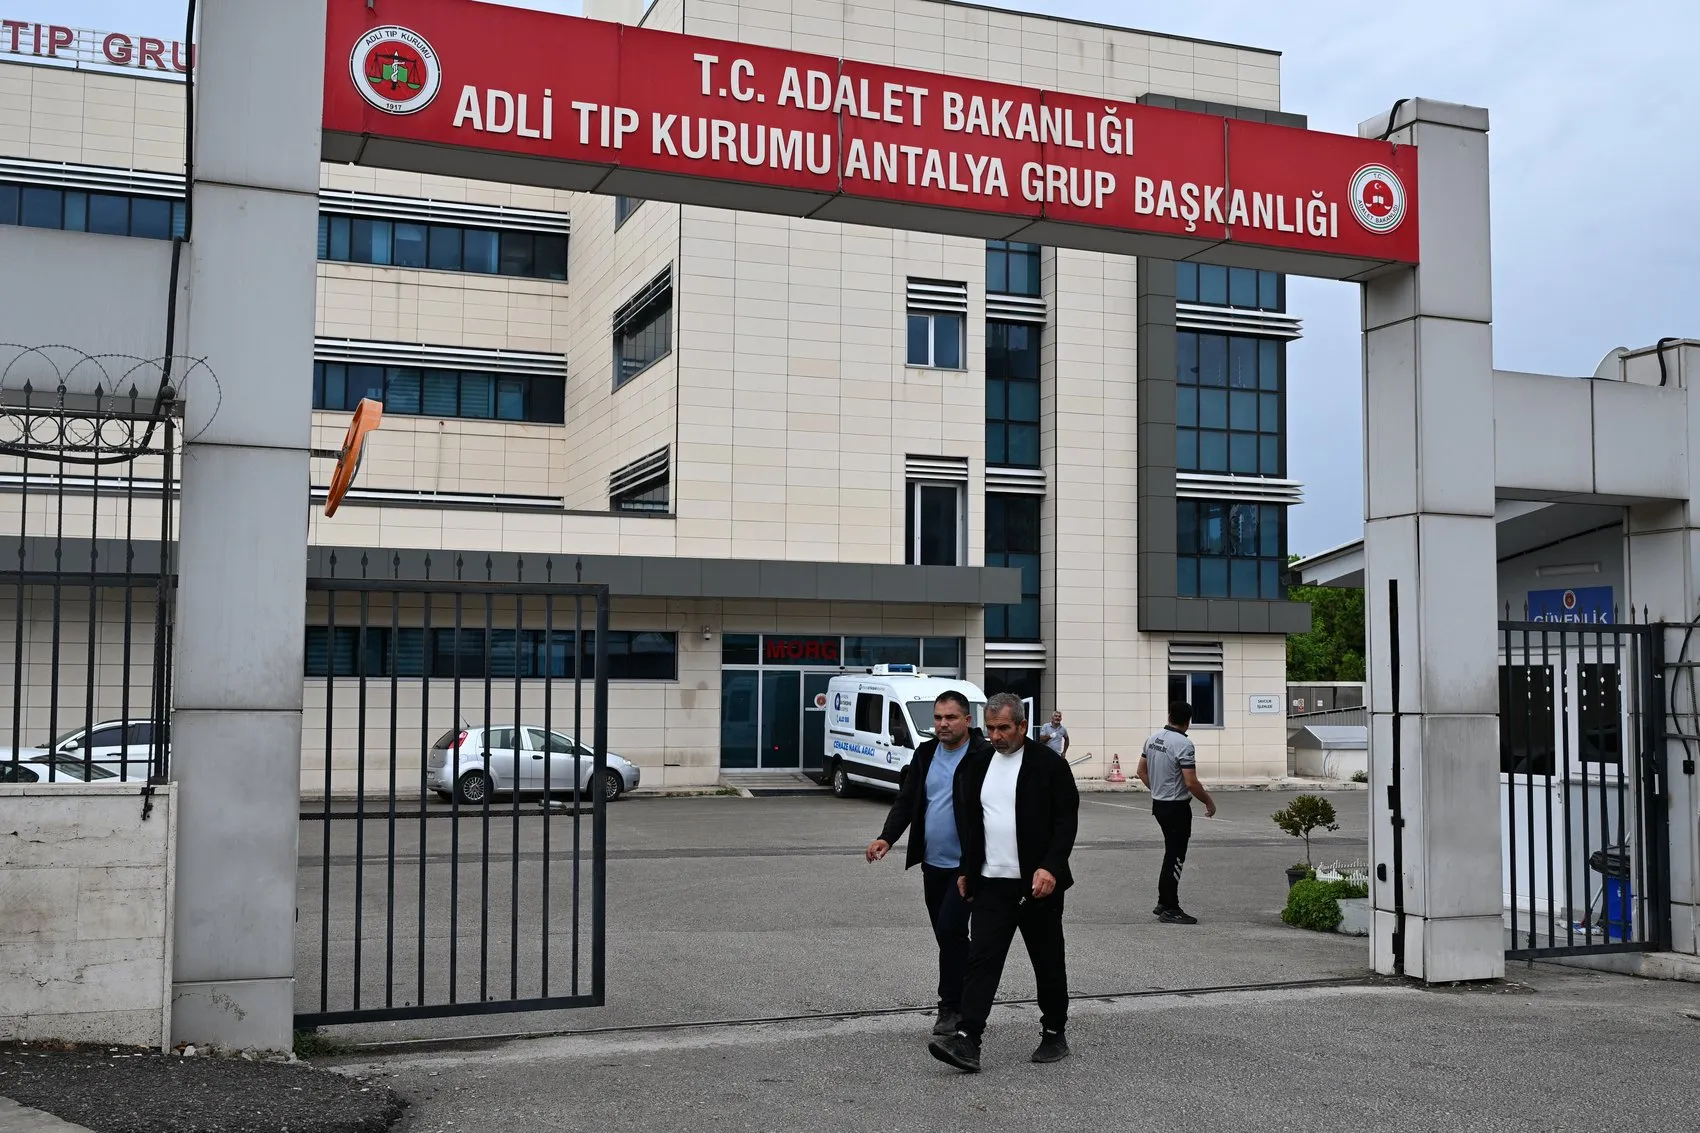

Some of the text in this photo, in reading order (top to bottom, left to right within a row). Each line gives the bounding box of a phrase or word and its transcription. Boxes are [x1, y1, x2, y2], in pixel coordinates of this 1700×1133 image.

[2, 20, 74, 57] TIP
[366, 30, 432, 59] ADLİ TIP KURUMU
[386, 103, 402, 111] 1917
[693, 52, 1135, 156] T.C. ADALET BAKANLIĞI
[452, 84, 1339, 239] ADLİ TIP KURUMU ANTALYA GRUP BAŞKANLIĞI
[1358, 199, 1374, 220] ADALET
[766, 639, 837, 660] MORG
